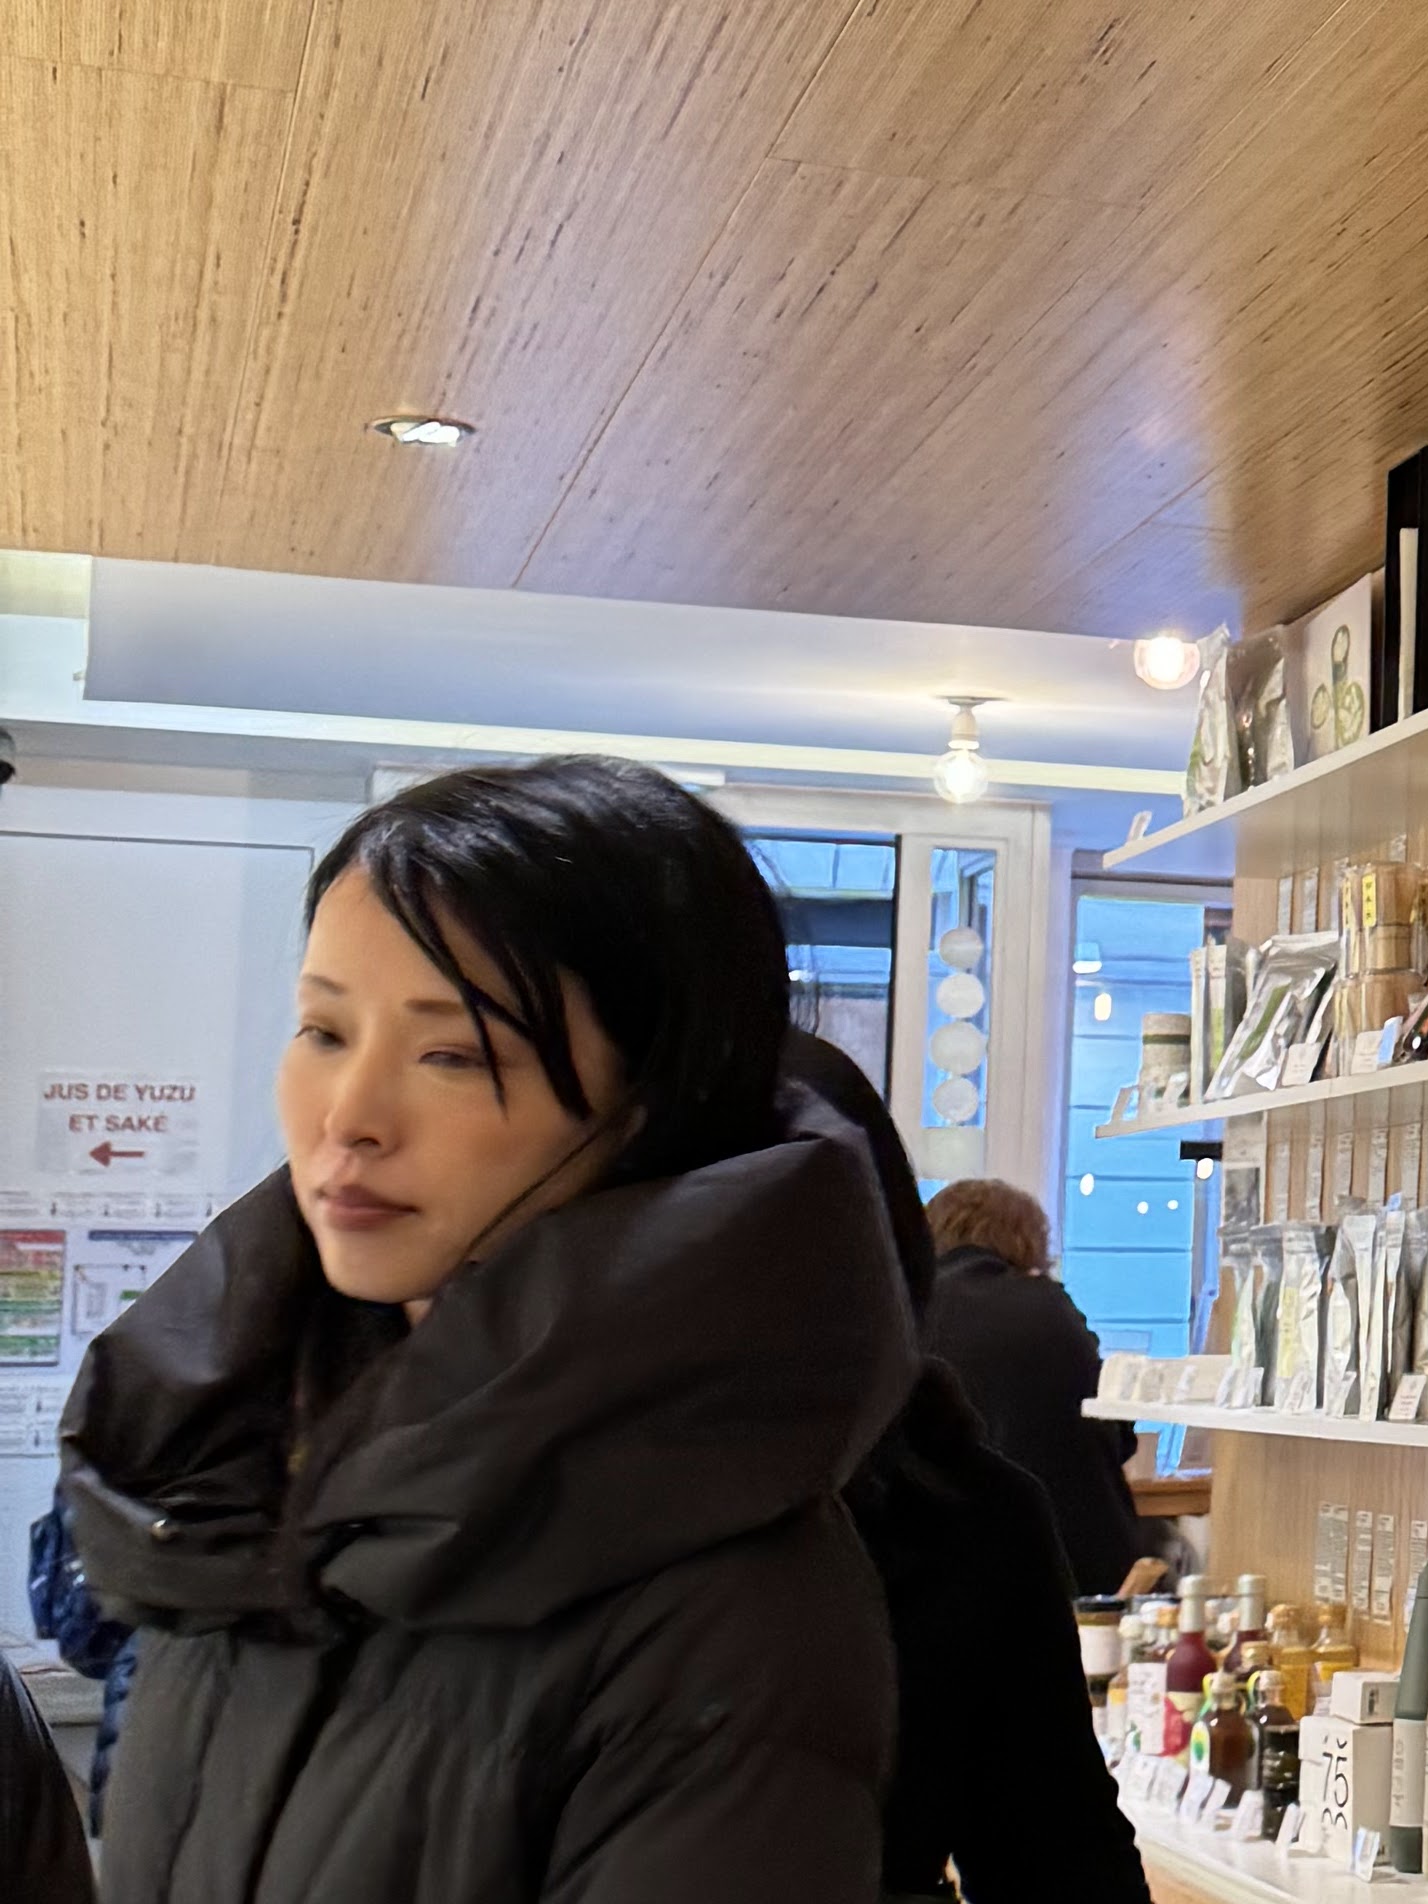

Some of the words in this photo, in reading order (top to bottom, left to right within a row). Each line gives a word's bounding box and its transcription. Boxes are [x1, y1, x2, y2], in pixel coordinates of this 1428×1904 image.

[43, 1082, 90, 1101] JUS
[96, 1083, 128, 1101] DE
[134, 1083, 196, 1102] YUZU
[69, 1113, 99, 1132] ET
